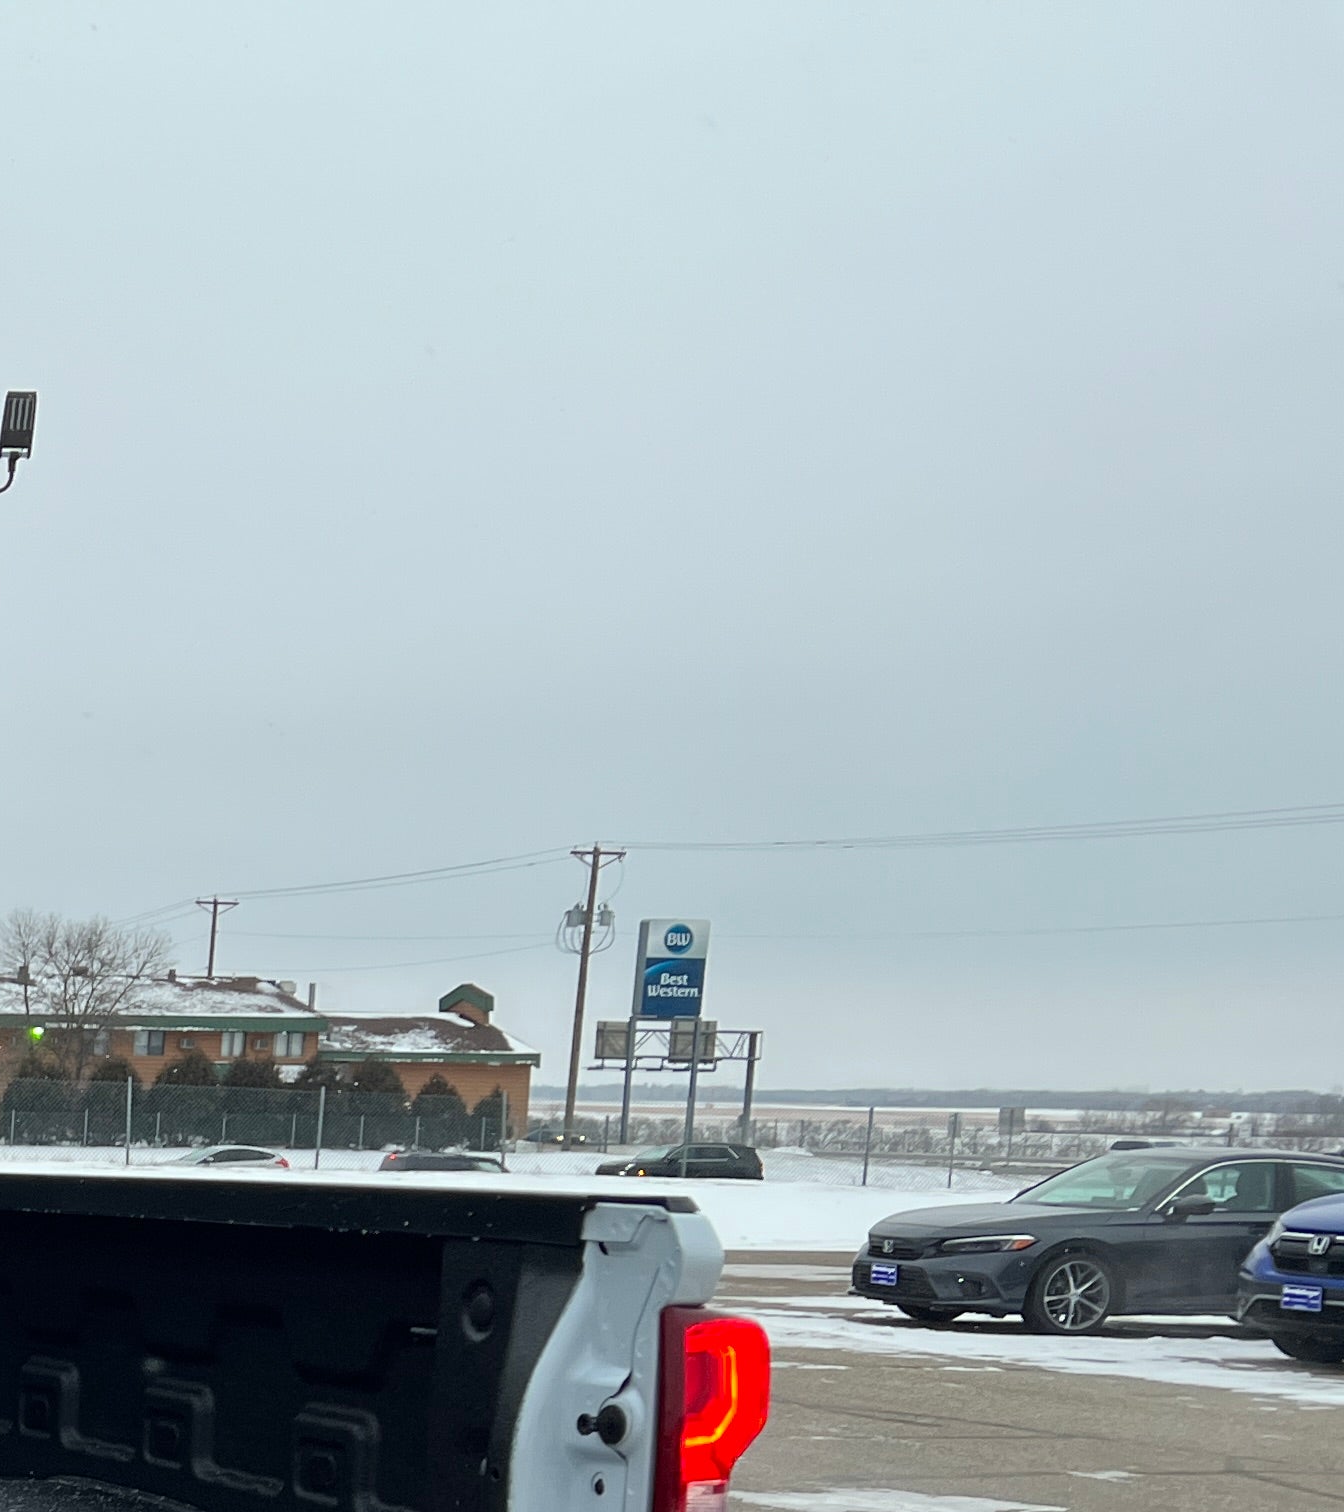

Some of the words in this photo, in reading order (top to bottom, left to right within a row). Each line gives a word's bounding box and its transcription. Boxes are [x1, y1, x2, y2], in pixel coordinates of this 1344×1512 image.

[666, 932, 691, 946] BW
[660, 972, 688, 985] Best
[647, 984, 699, 998] Western
